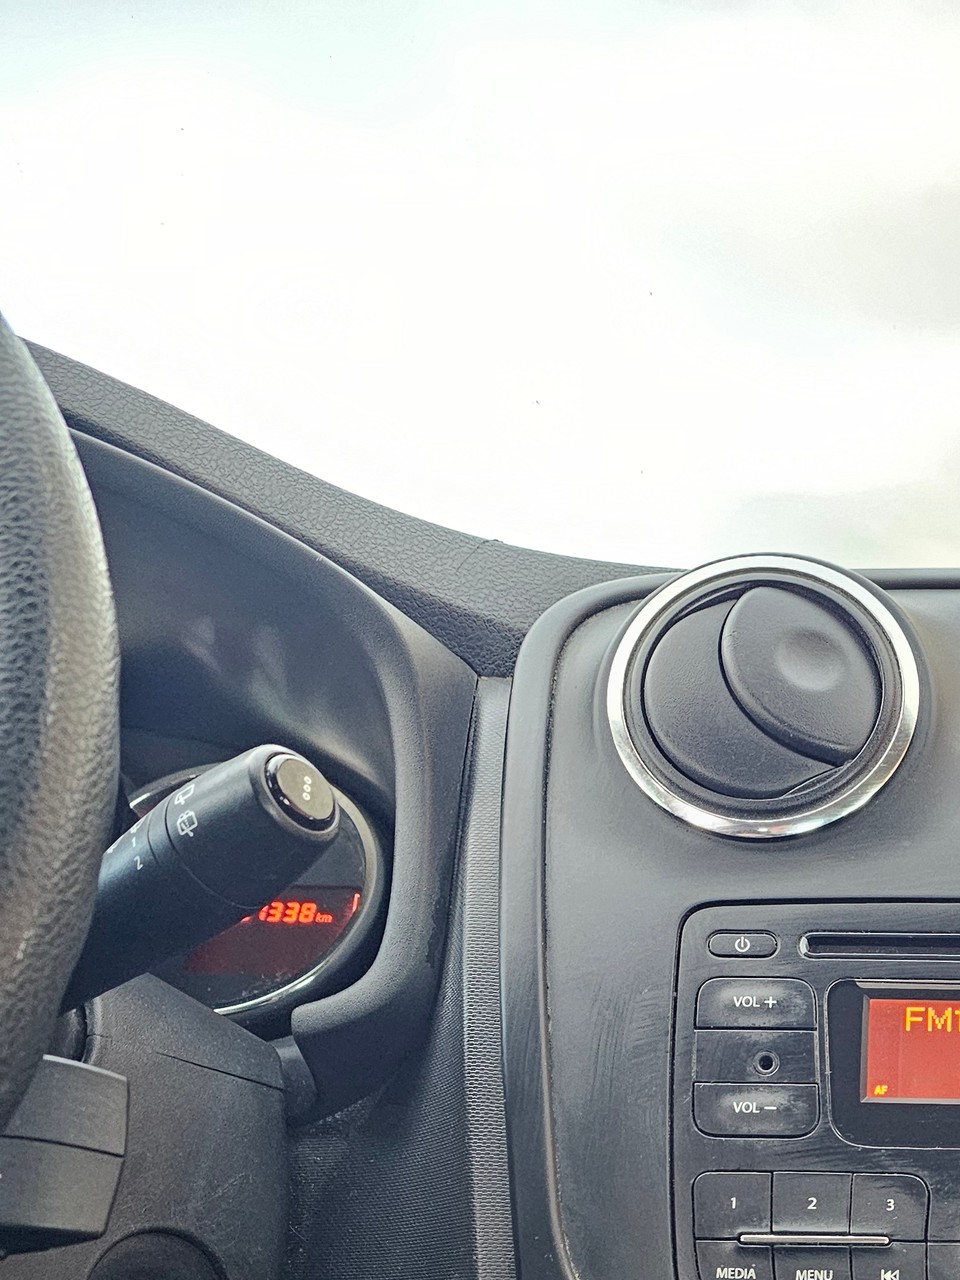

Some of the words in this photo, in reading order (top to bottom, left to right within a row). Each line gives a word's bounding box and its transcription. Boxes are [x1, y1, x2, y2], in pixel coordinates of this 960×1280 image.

[315, 912, 333, 923] km
[733, 995, 761, 1008] VOL
[733, 1101, 761, 1114] VOL
[729, 1196, 737, 1209] 1
[807, 1196, 818, 1210] 2
[885, 1198, 896, 1212] 3
[715, 1267, 757, 1280] MEDIA
